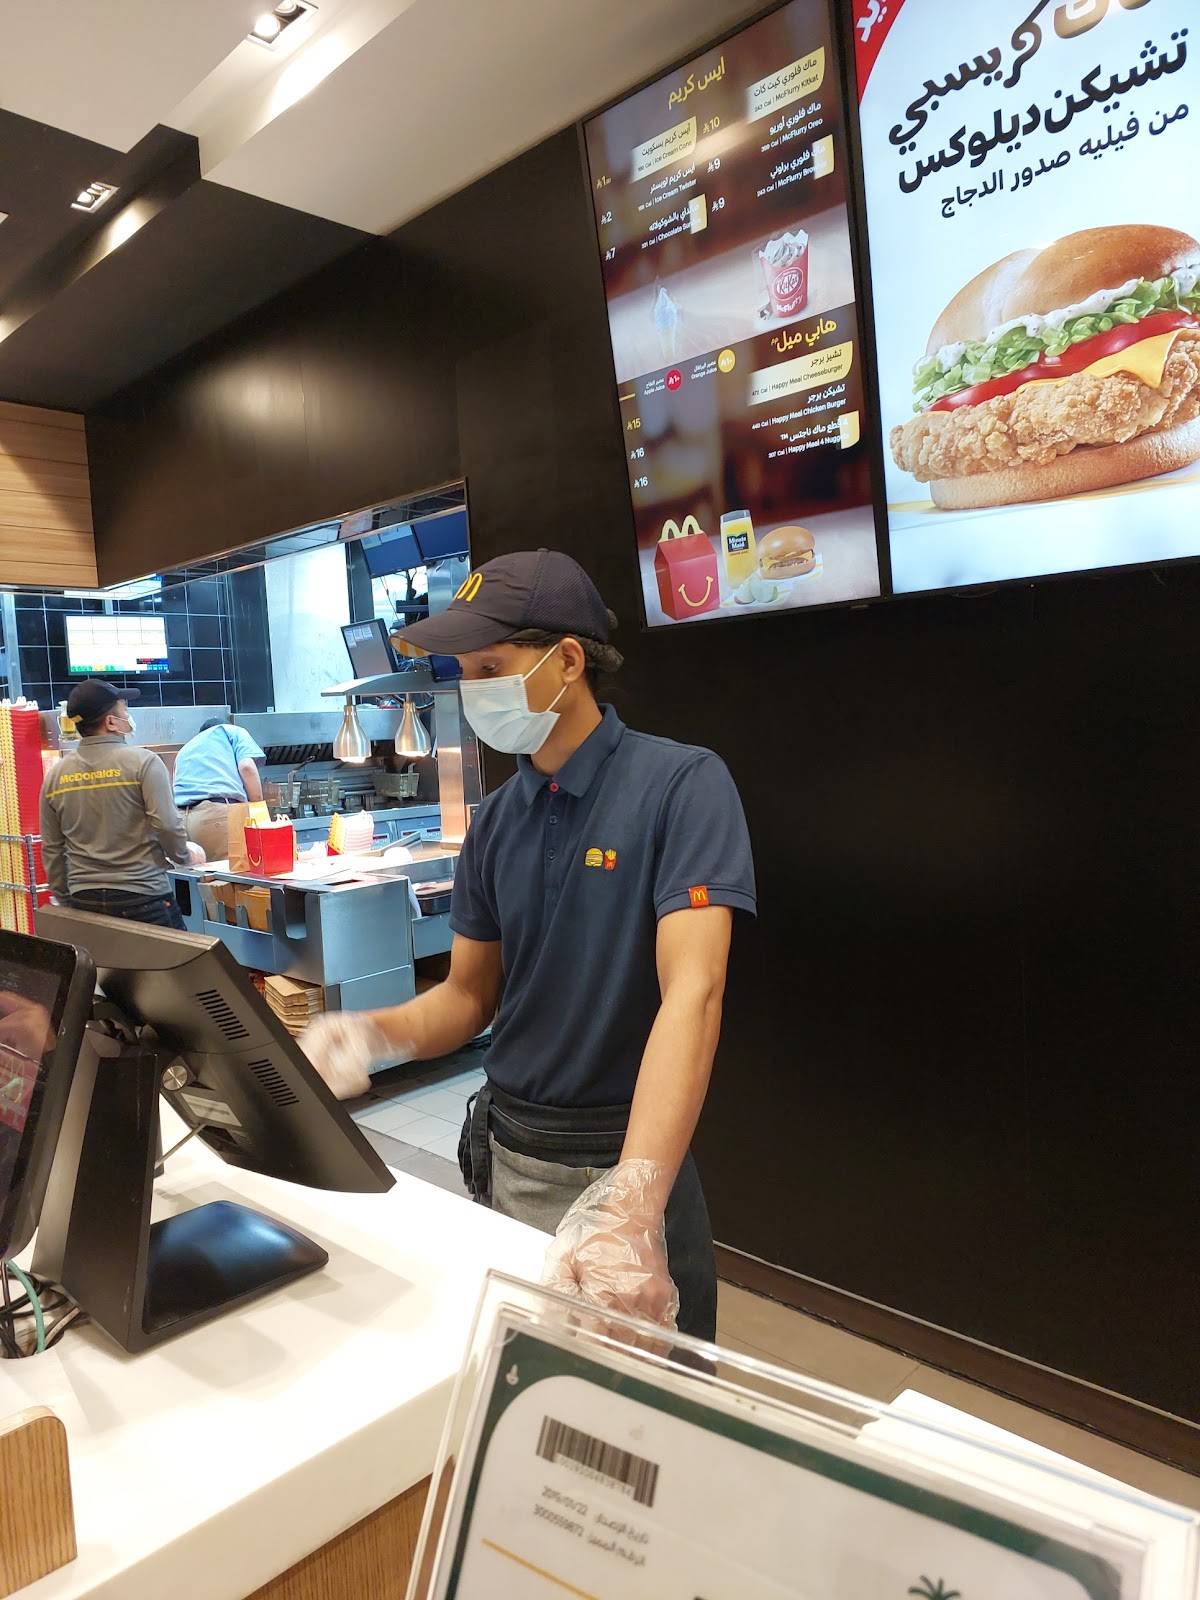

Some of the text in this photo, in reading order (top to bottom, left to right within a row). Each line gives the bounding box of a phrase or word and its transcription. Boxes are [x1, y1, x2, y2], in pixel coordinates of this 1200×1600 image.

[802, 59, 817, 71] ماك
[668, 56, 725, 111] ايس كريم
[781, 65, 802, 86] فلوري
[753, 83, 766, 97] كات
[775, 84, 800, 102] McFlurry
[800, 74, 819, 88] Kitkat
[806, 102, 822, 115] ماك
[898, 27, 1189, 194] تشيكن ديلوكس
[785, 108, 806, 129] فلوري
[664, 131, 677, 147] كريم
[770, 139, 779, 148] Cal
[782, 124, 807, 143] McFlurry
[807, 118, 823, 130] Oreo
[641, 140, 664, 156] بسكويت
[662, 148, 679, 159] Cream
[790, 149, 810, 170] فلوري
[939, 102, 1190, 219] من فيليه صدور الدجاج
[668, 169, 682, 186] كريم
[766, 184, 774, 192] Cal
[777, 170, 803, 188] McFlurry
[662, 187, 679, 199] Cream
[657, 225, 682, 241] Chocolate
[777, 318, 837, 353] هابي ميل
[826, 349, 842, 363] تشيز
[771, 380, 788, 391] Happy
[789, 375, 802, 384] Meal
[803, 364, 843, 381] Cheeseburger
[822, 383, 846, 399] تشيكن
[772, 415, 789, 425] Happy
[789, 410, 803, 420] Meal
[803, 404, 827, 415] Chicken
[826, 398, 847, 410] Burger
[812, 424, 826, 434] ماك
[788, 443, 806, 454] Happy
[806, 439, 820, 449] Meal
